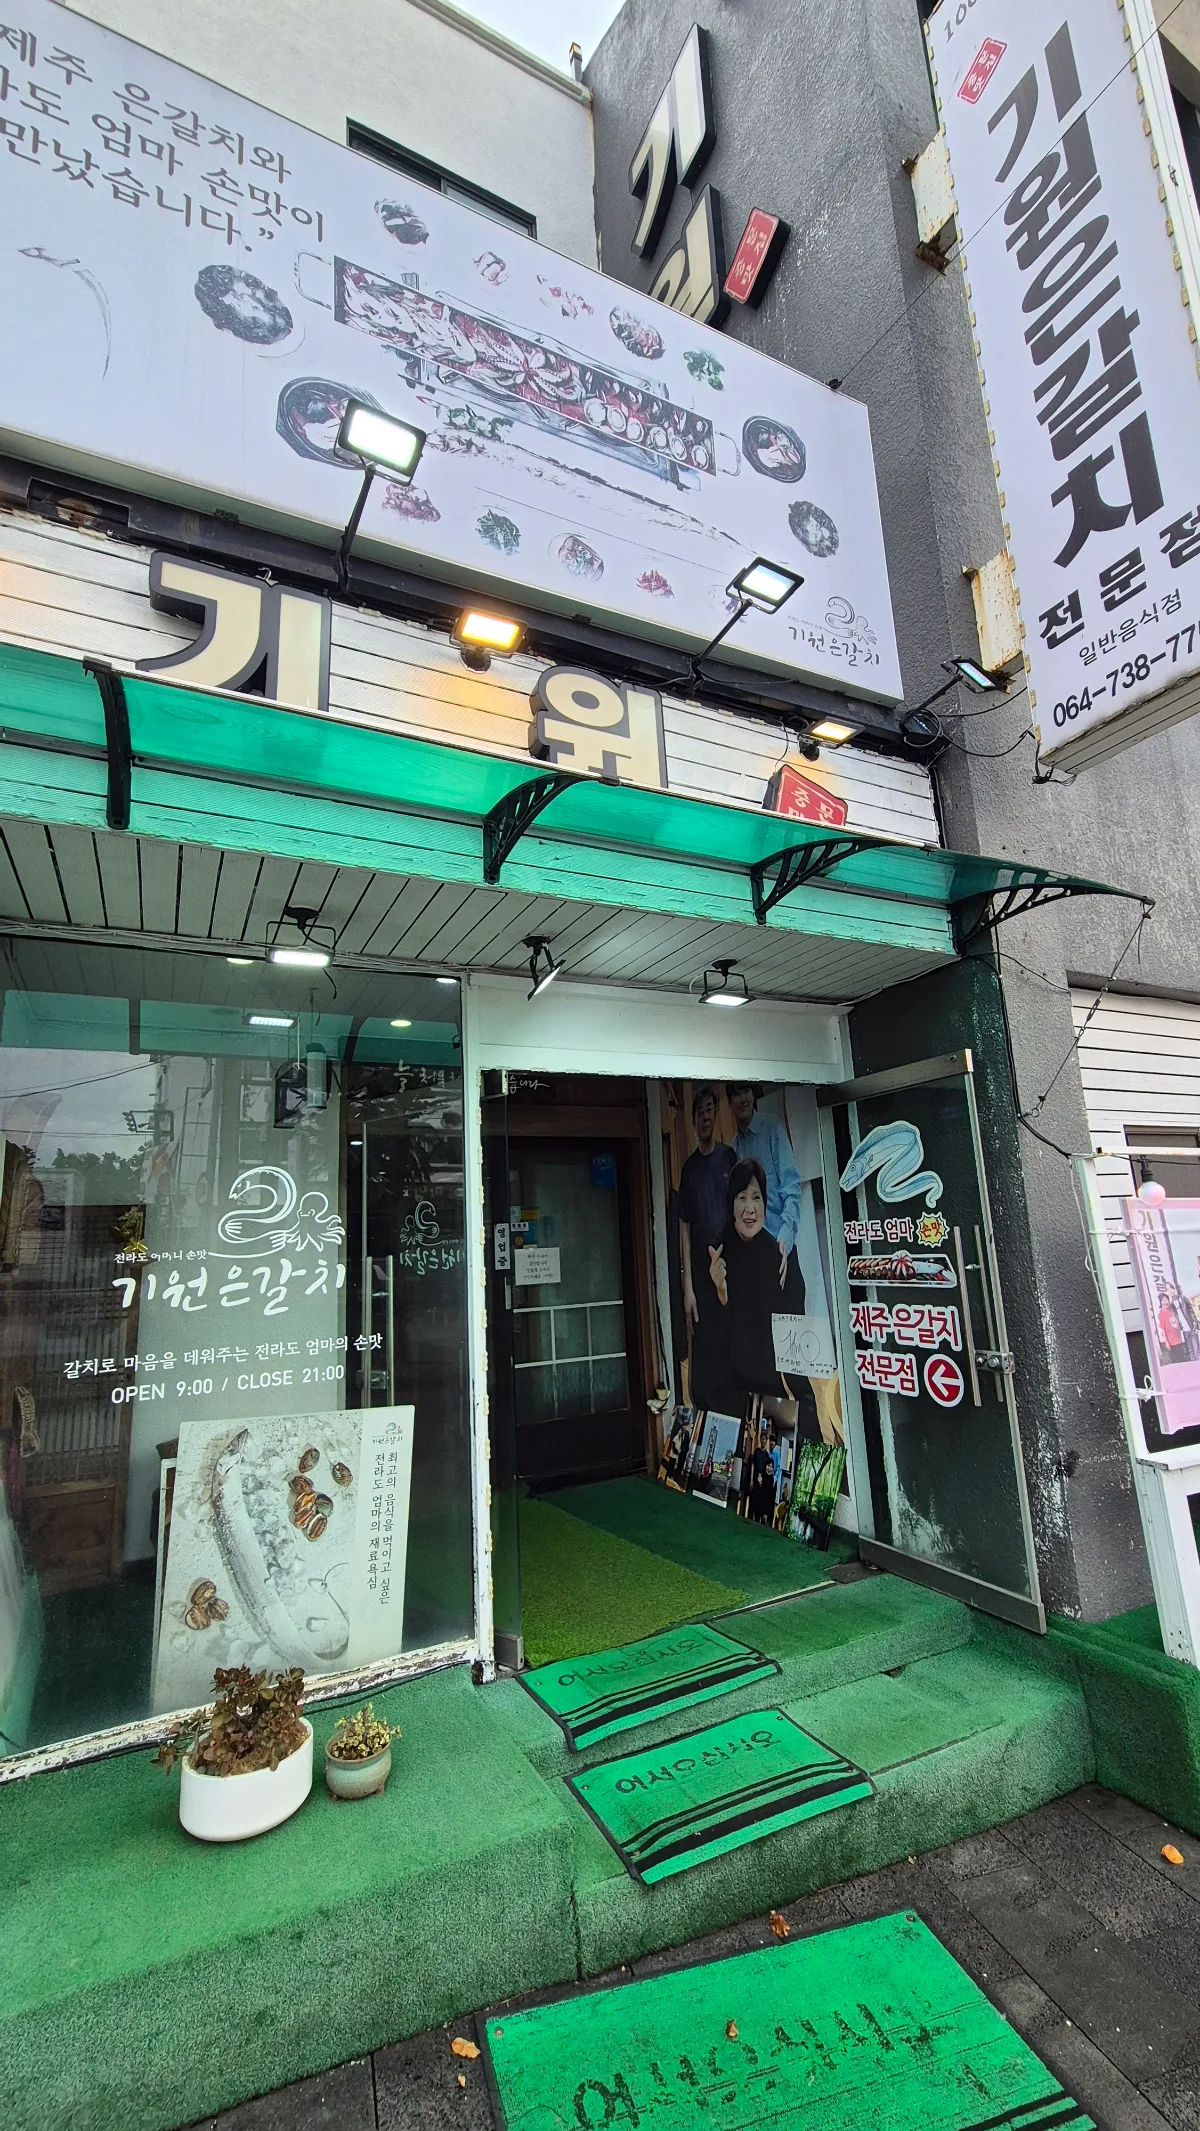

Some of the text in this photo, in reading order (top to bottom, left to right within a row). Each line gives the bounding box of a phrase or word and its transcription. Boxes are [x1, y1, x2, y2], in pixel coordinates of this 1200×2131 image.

[0, 24, 291, 184] 제주 은갈치와
[91, 113, 183, 176] 엄마
[200, 167, 323, 243] 손맛이
[1079, 588, 1182, 667] 일반음식점
[1053, 619, 1200, 728] 064-738-77
[791, 786, 835, 824] 중문
[113, 1249, 208, 1264] 전라도 어머니 손맛
[845, 1217, 944, 1243] 전라도 엄마 손맛
[63, 1332, 384, 1380] 갈치로 마음을 데워주는 전라도 엄마의 손맛
[111, 1364, 346, 1405] OPEN 9:00 / CLOSE 21:00
[856, 1353, 916, 1392] 전문점
[366, 1452, 385, 1590] 전라도 엄마의 재료욕심
[378, 1451, 398, 1604] 최고의 음식을 먹이고 싶은
